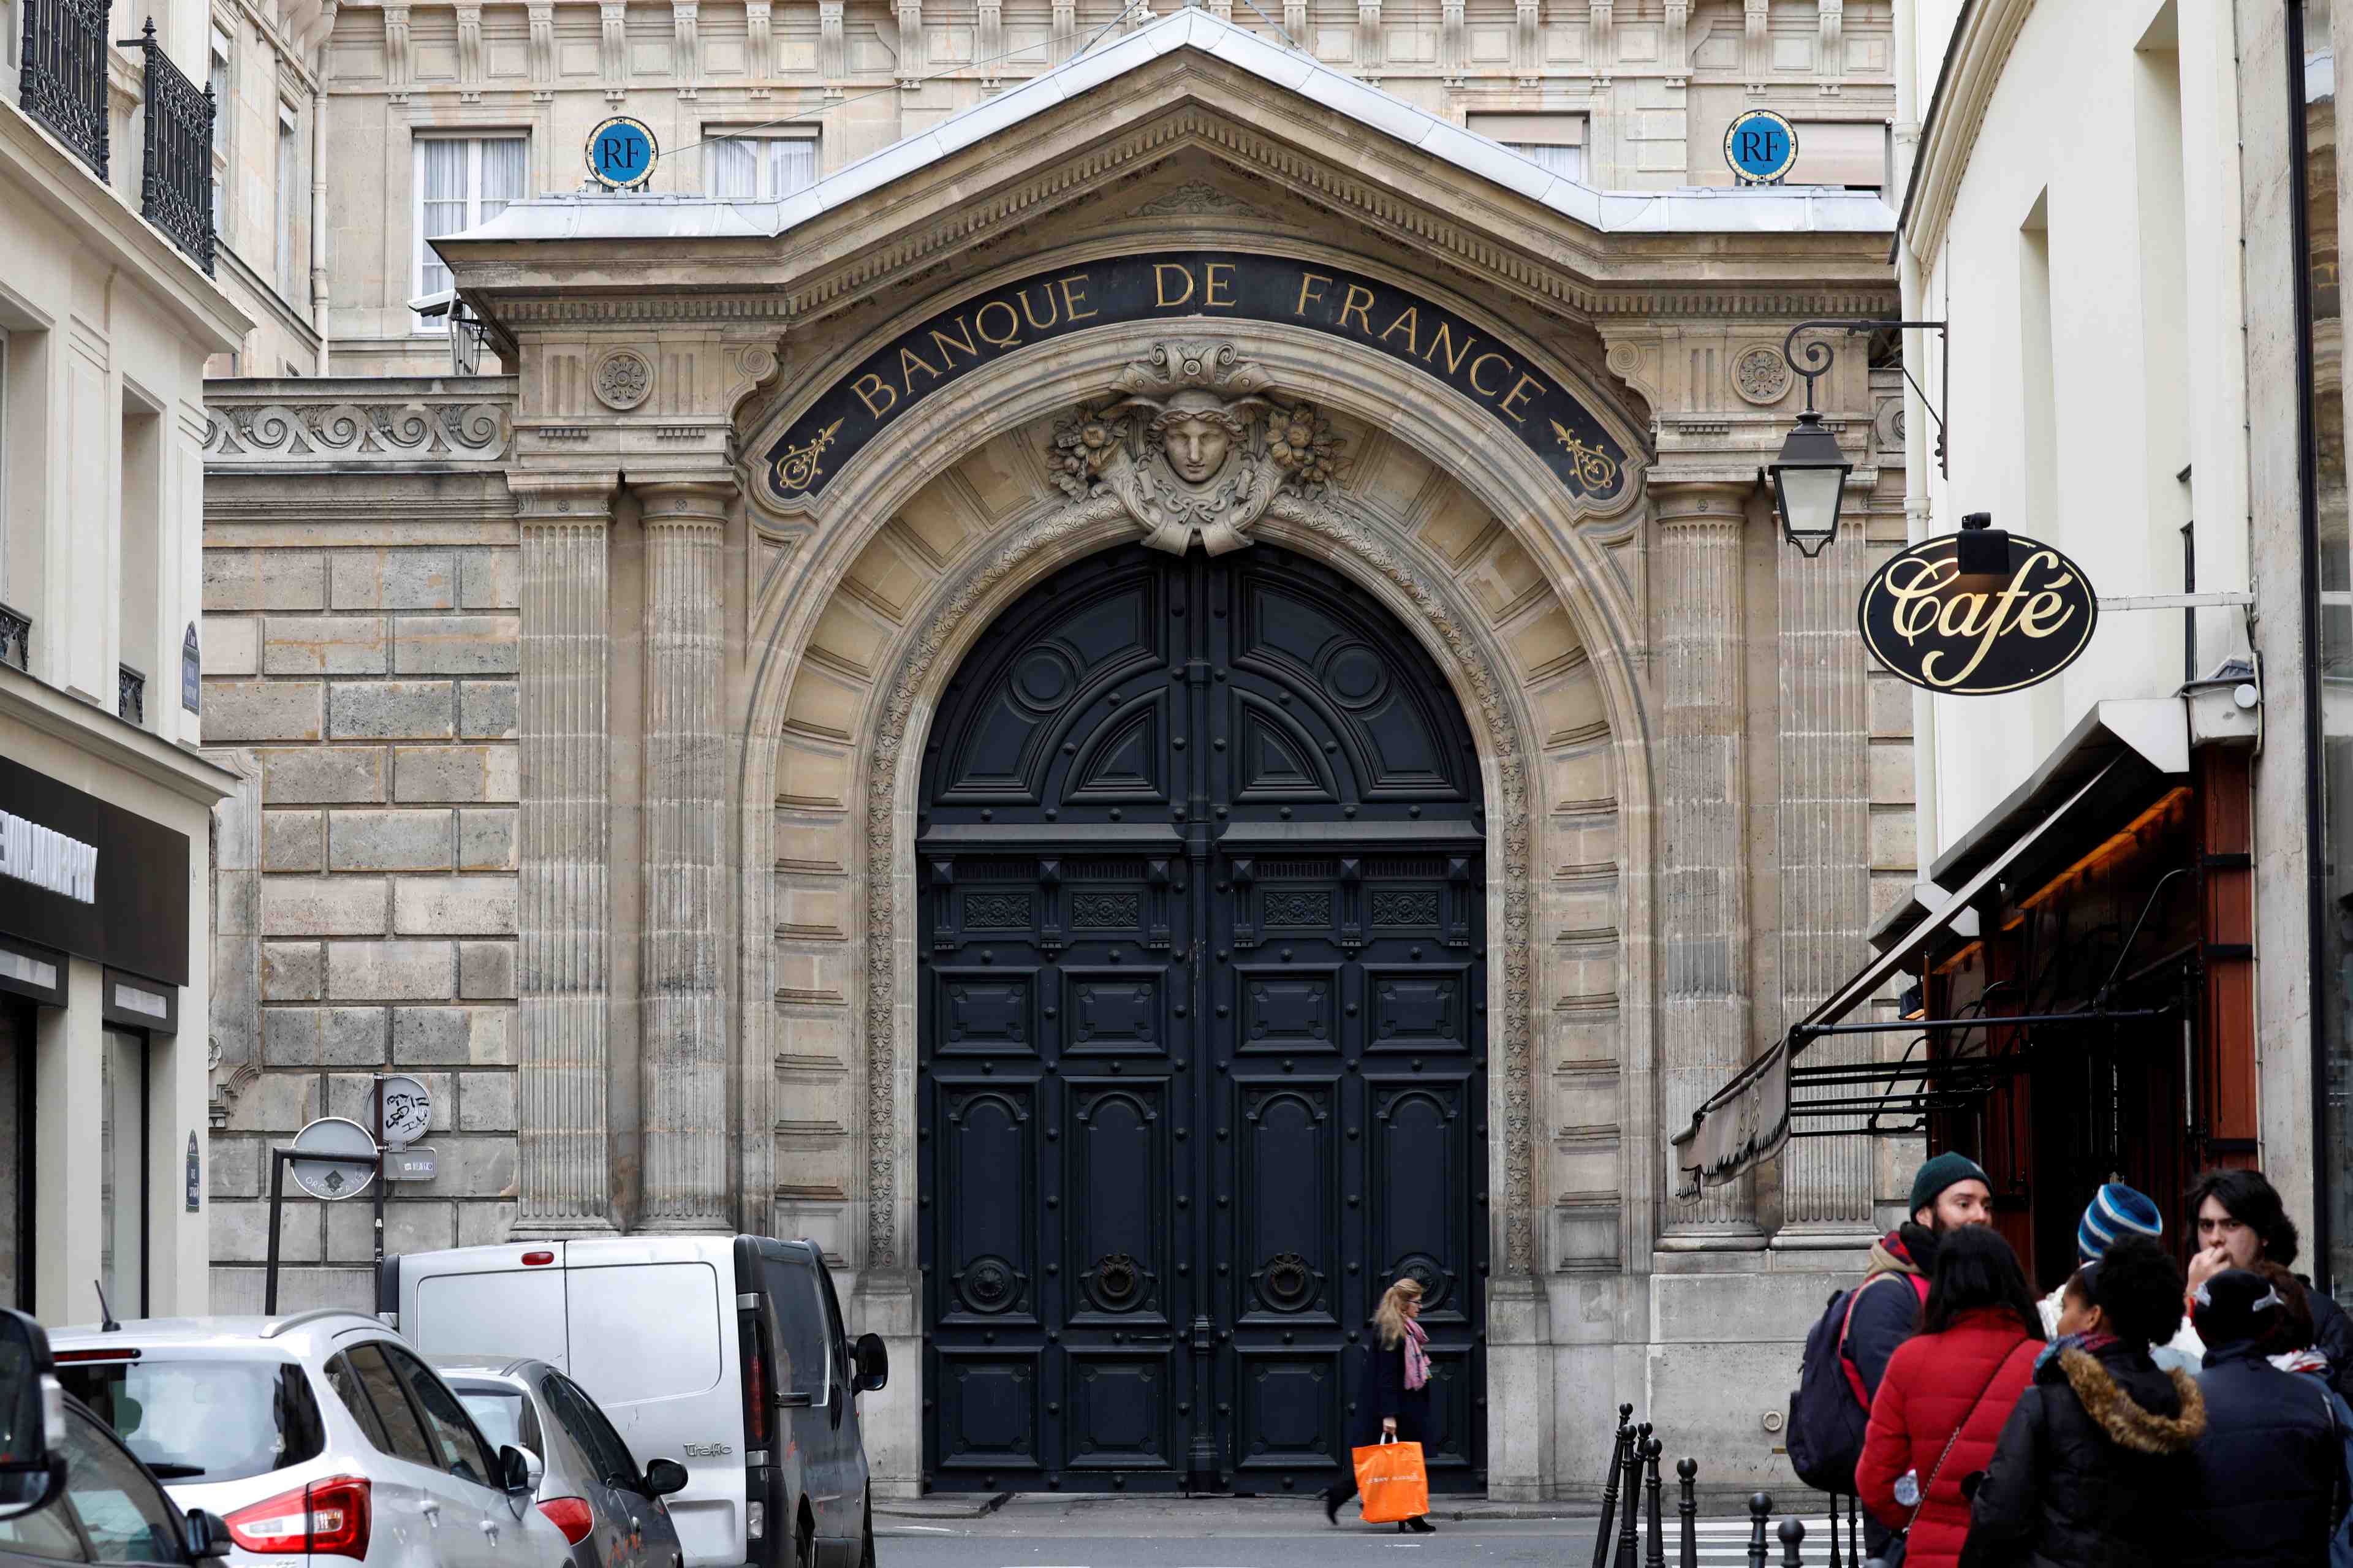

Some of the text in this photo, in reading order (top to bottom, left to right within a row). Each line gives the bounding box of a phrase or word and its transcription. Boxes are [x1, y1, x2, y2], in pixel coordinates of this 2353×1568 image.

[602, 137, 643, 169] RF
[1741, 131, 1781, 162] RF
[851, 262, 1548, 423] BANQUE DE FRANCE
[1885, 550, 2075, 687] Café
[683, 1441, 733, 1457] Trafic
